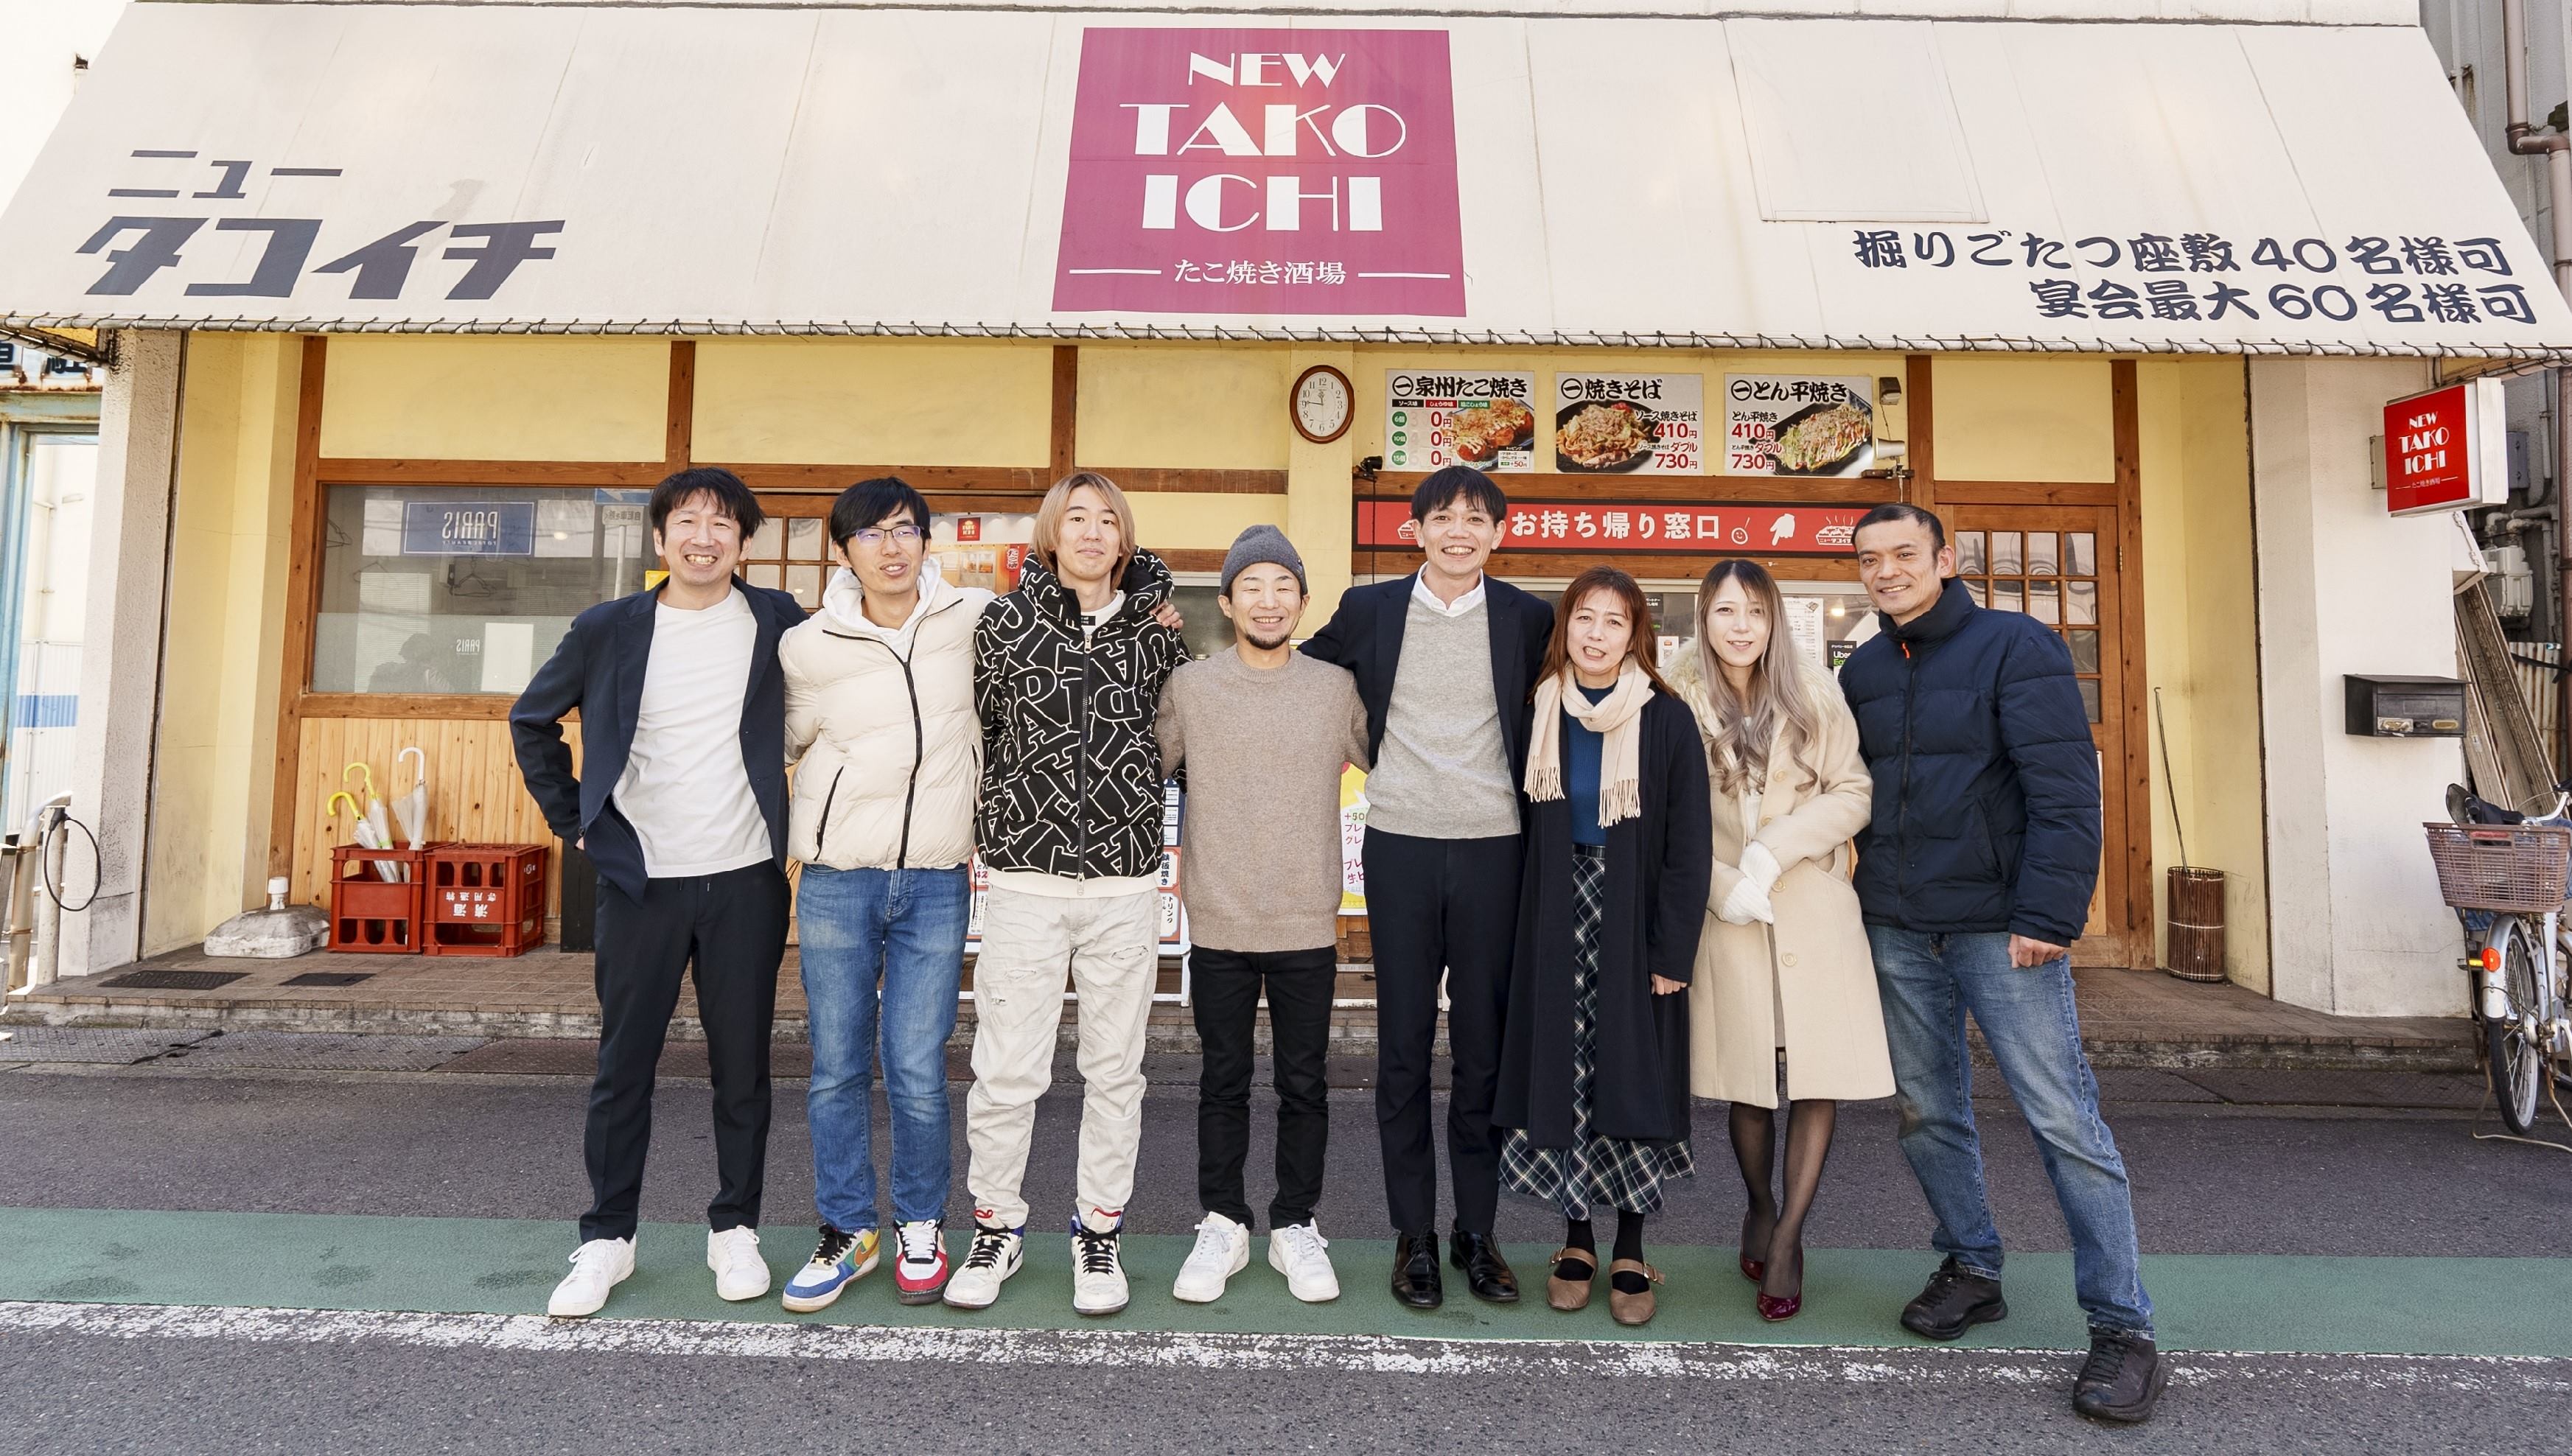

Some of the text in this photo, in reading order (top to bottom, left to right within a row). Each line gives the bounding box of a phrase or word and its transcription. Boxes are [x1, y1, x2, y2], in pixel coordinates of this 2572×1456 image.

[1188, 52, 1346, 88] NEW
[1119, 101, 1407, 158] TAKO
[108, 150, 343, 199] ニュー
[1142, 174, 1383, 232] ICHI
[75, 216, 566, 300] タコイチ
[1174, 259, 1346, 286] たこ焼き酒場
[1416, 376, 1527, 398] 泉州たこ焼き
[1585, 378, 1663, 400] 焼きそば
[1753, 381, 1848, 402] とん平焼き
[1635, 410, 1698, 422] ソース焼きそば
[1732, 410, 1778, 422] とん平焼き
[2409, 411, 2439, 430] NEW
[1654, 423, 1698, 439] 410円
[1732, 423, 1775, 440] 410円
[2399, 427, 2450, 454] TAKO
[1670, 442, 1698, 452] ダブル
[1755, 443, 1782, 454] ダブル
[1654, 454, 1698, 470] 730円
[1732, 454, 1775, 470] 730円
[2405, 449, 2446, 475] ICHI
[1511, 510, 1720, 539] お持ち帰り窓口
